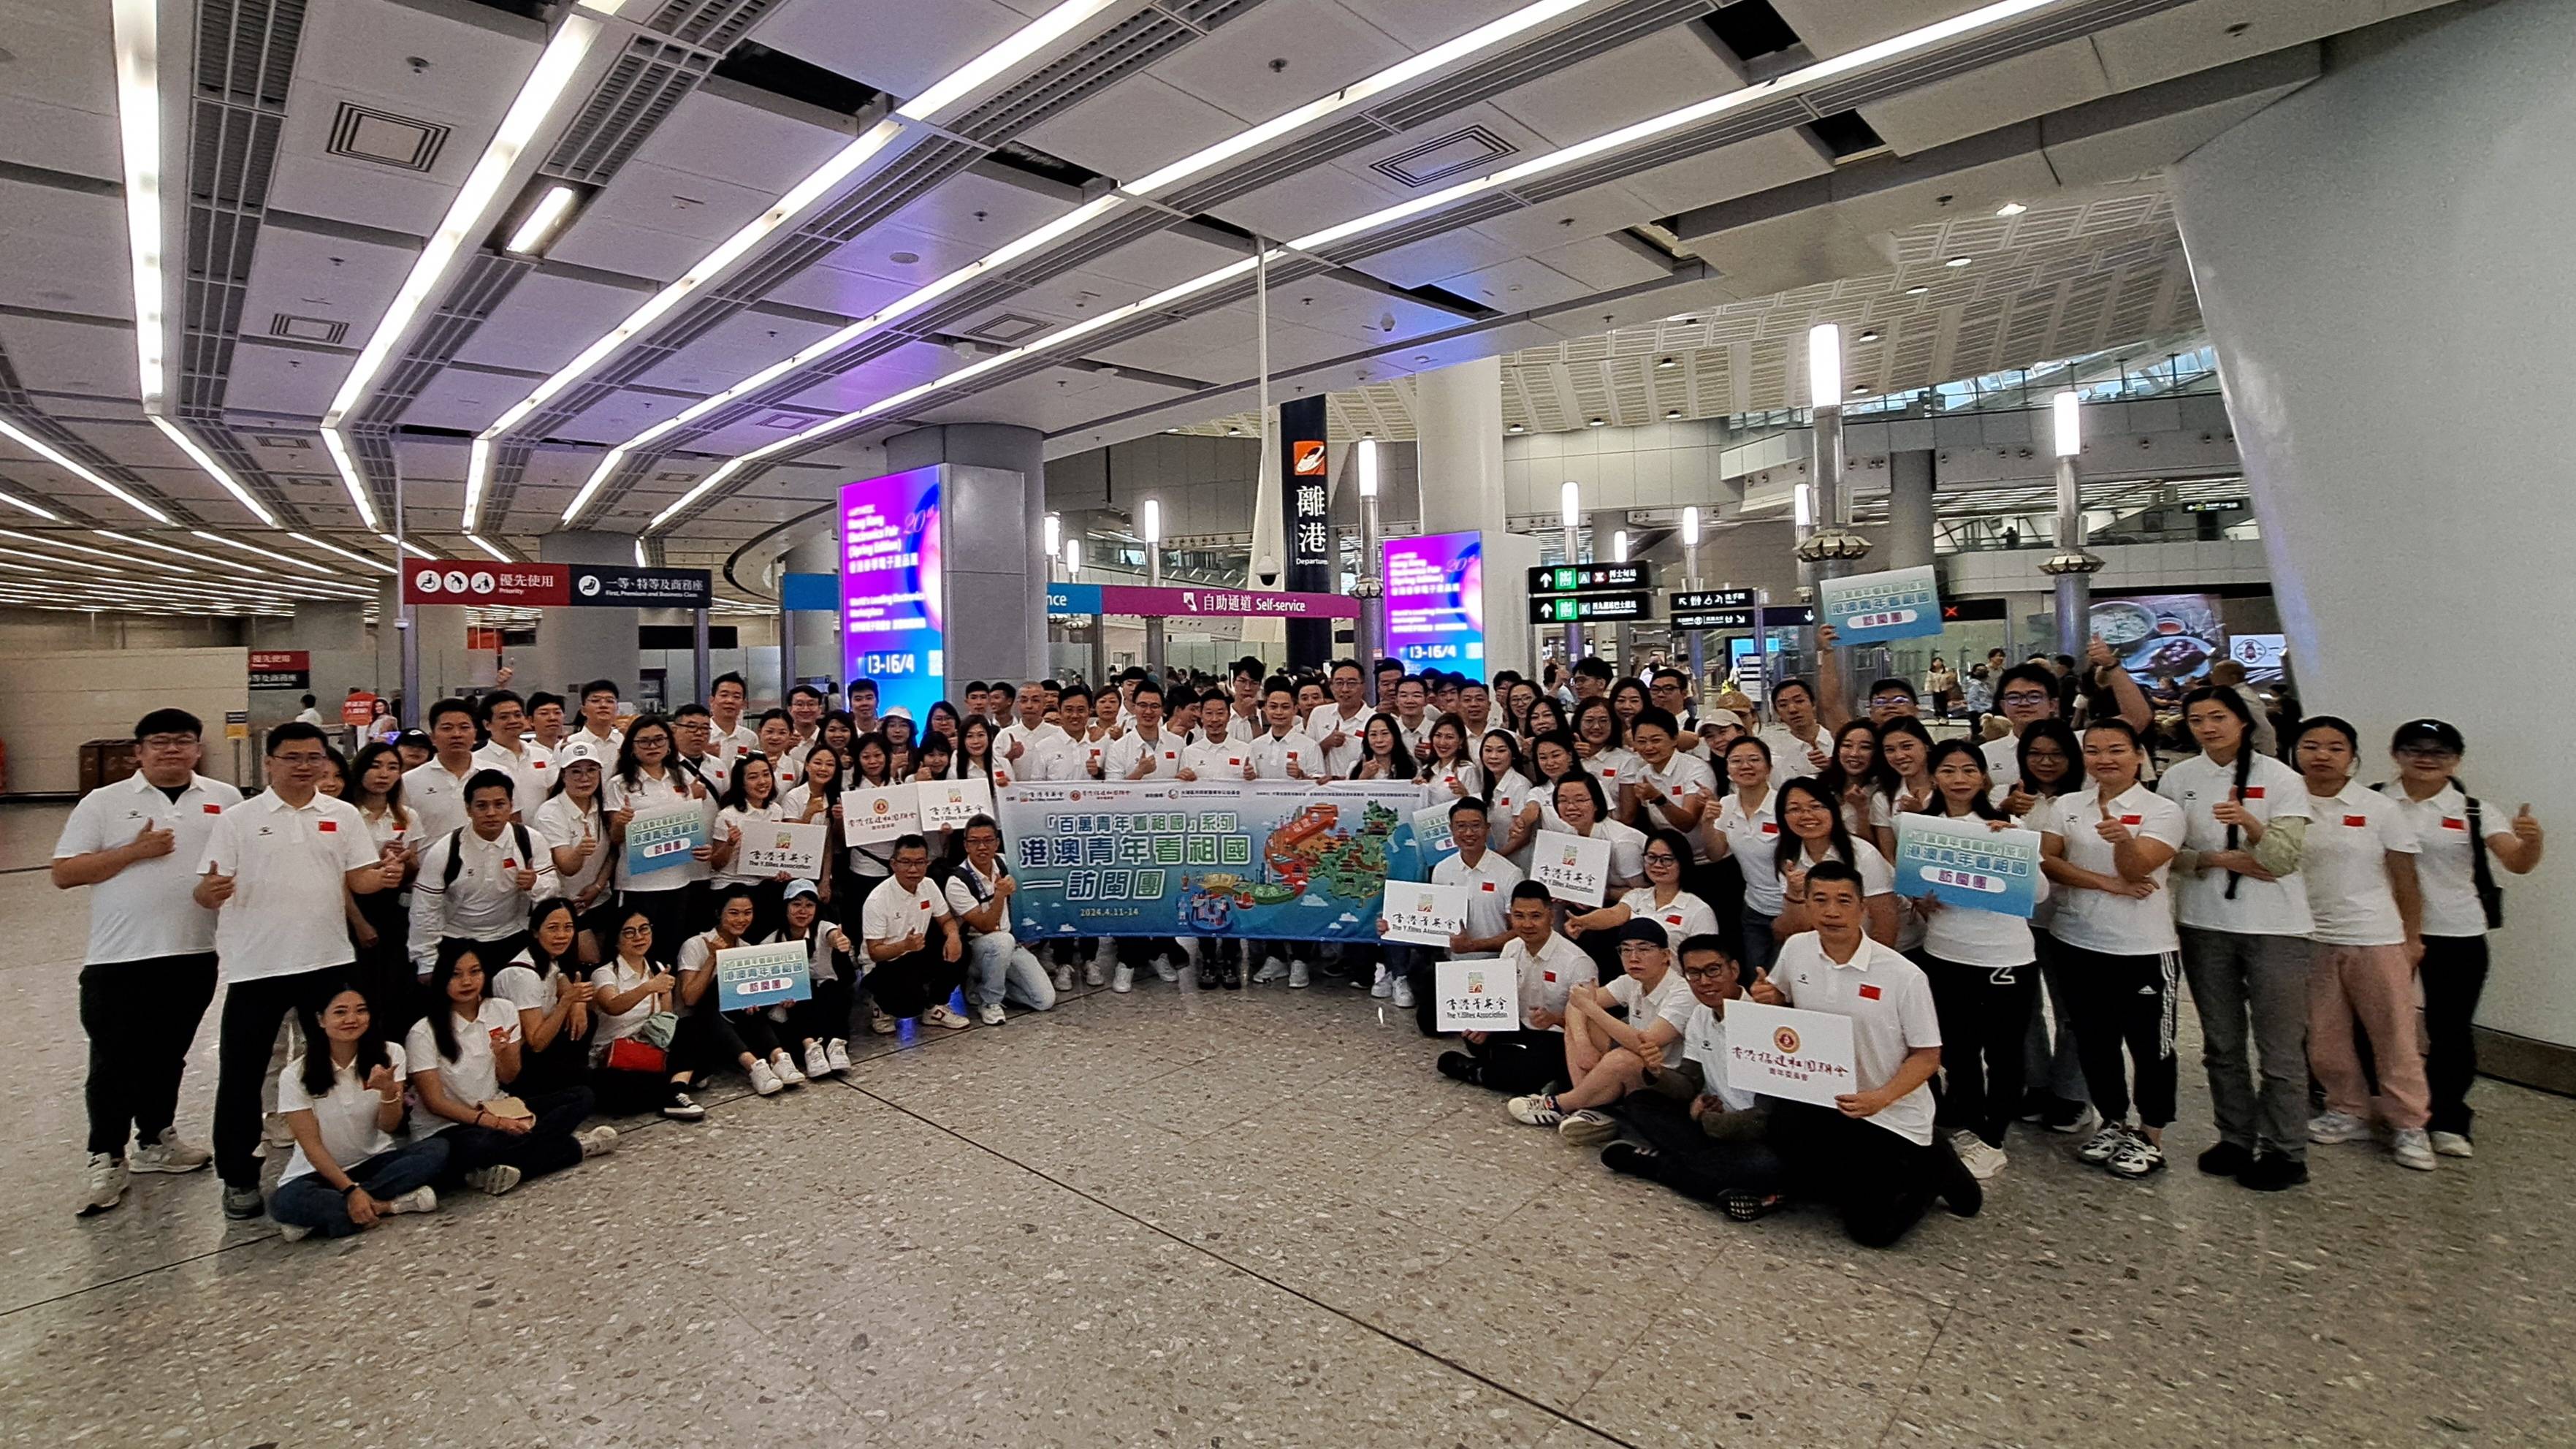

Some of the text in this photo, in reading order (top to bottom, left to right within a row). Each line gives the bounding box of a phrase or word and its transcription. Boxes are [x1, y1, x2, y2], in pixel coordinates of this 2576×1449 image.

[1296, 485, 1326, 552] 離港
[500, 573, 554, 587] 優先使用
[606, 577, 704, 591] 一等、特等及商務座
[499, 587, 525, 596] Priority
[1204, 594, 1306, 612] 自助通道 Self-service
[1410, 645, 1456, 658] 13-16/4
[868, 654, 915, 674] 13-16/4
[1047, 813, 1236, 834] 「百萬青年看祖國」系列
[1020, 834, 1251, 868] 港澳青年看祖國
[1081, 908, 1138, 917] 2024.4.11-14
